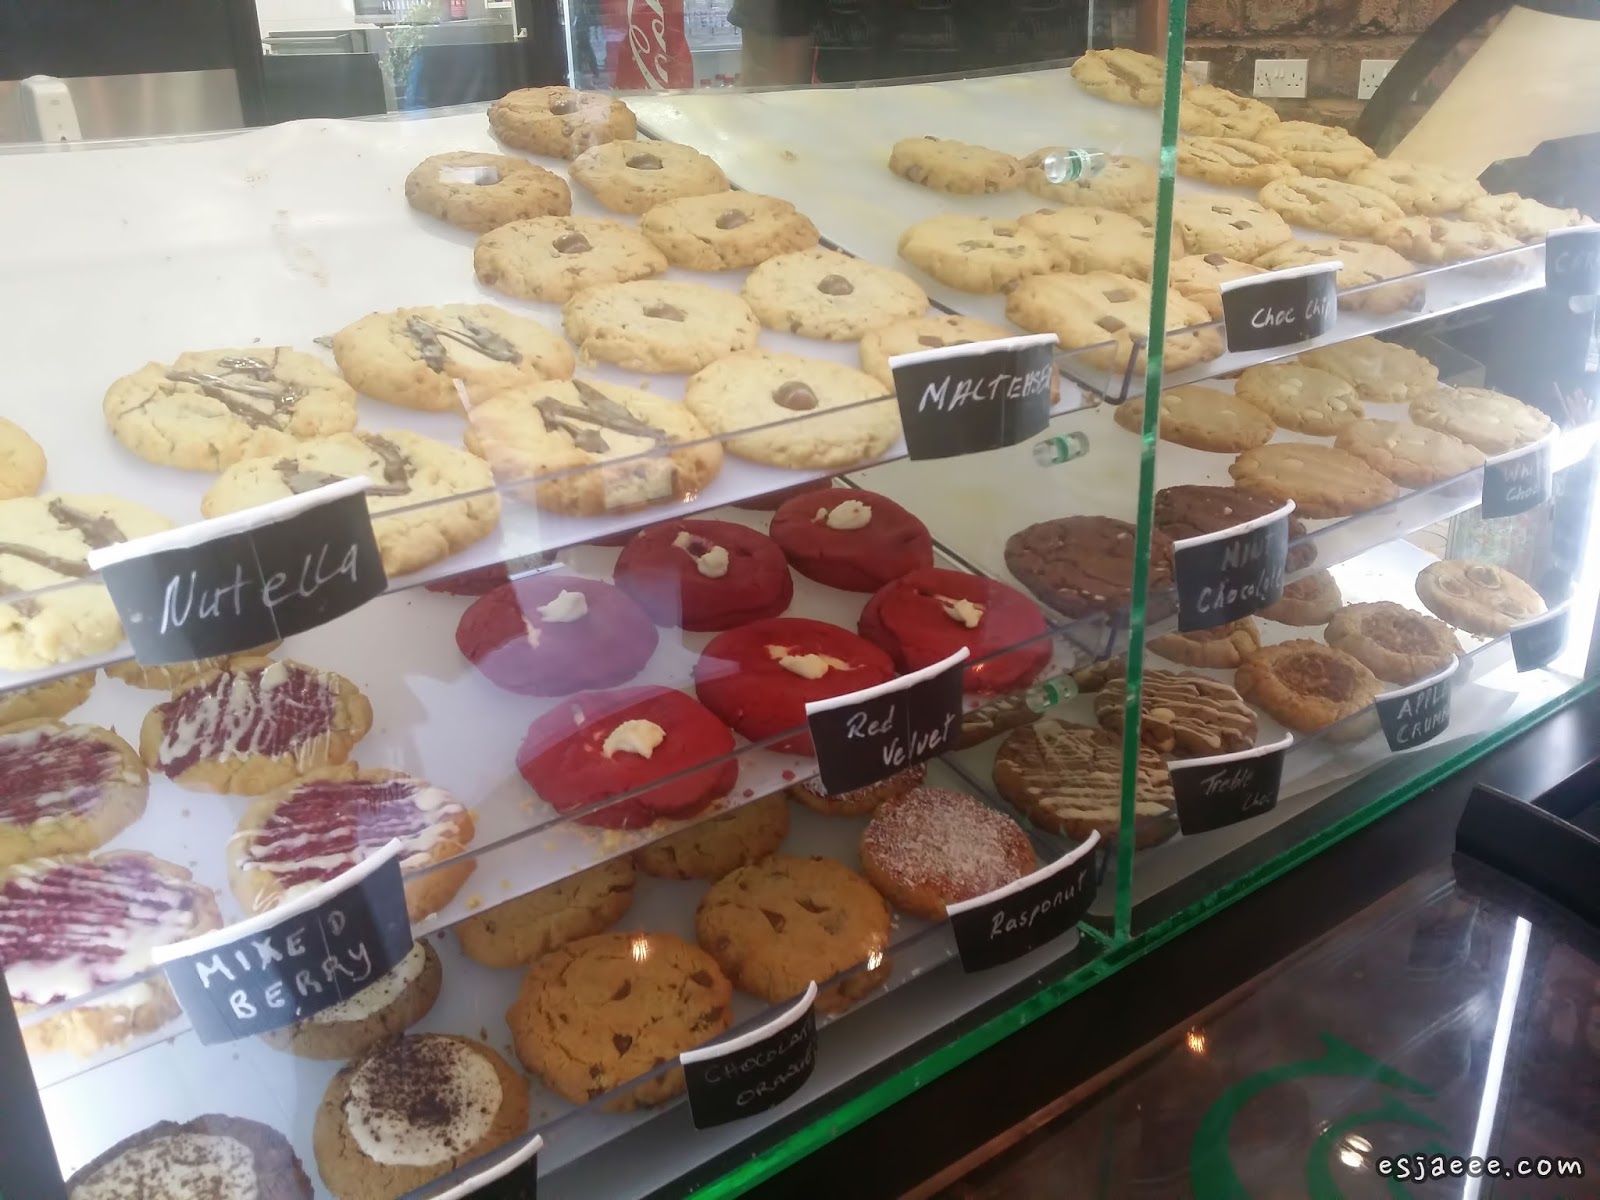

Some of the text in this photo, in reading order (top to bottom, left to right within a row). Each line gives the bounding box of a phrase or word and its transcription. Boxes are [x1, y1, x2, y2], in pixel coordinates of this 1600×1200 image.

[1251, 296, 1331, 329] Choc Chip
[160, 543, 358, 635] Nutella
[846, 704, 895, 739] Red
[883, 713, 955, 766] Velvet
[990, 869, 1087, 940] Rasponut
[195, 910, 346, 989] MIXED
[230, 942, 372, 1019] BERRY
